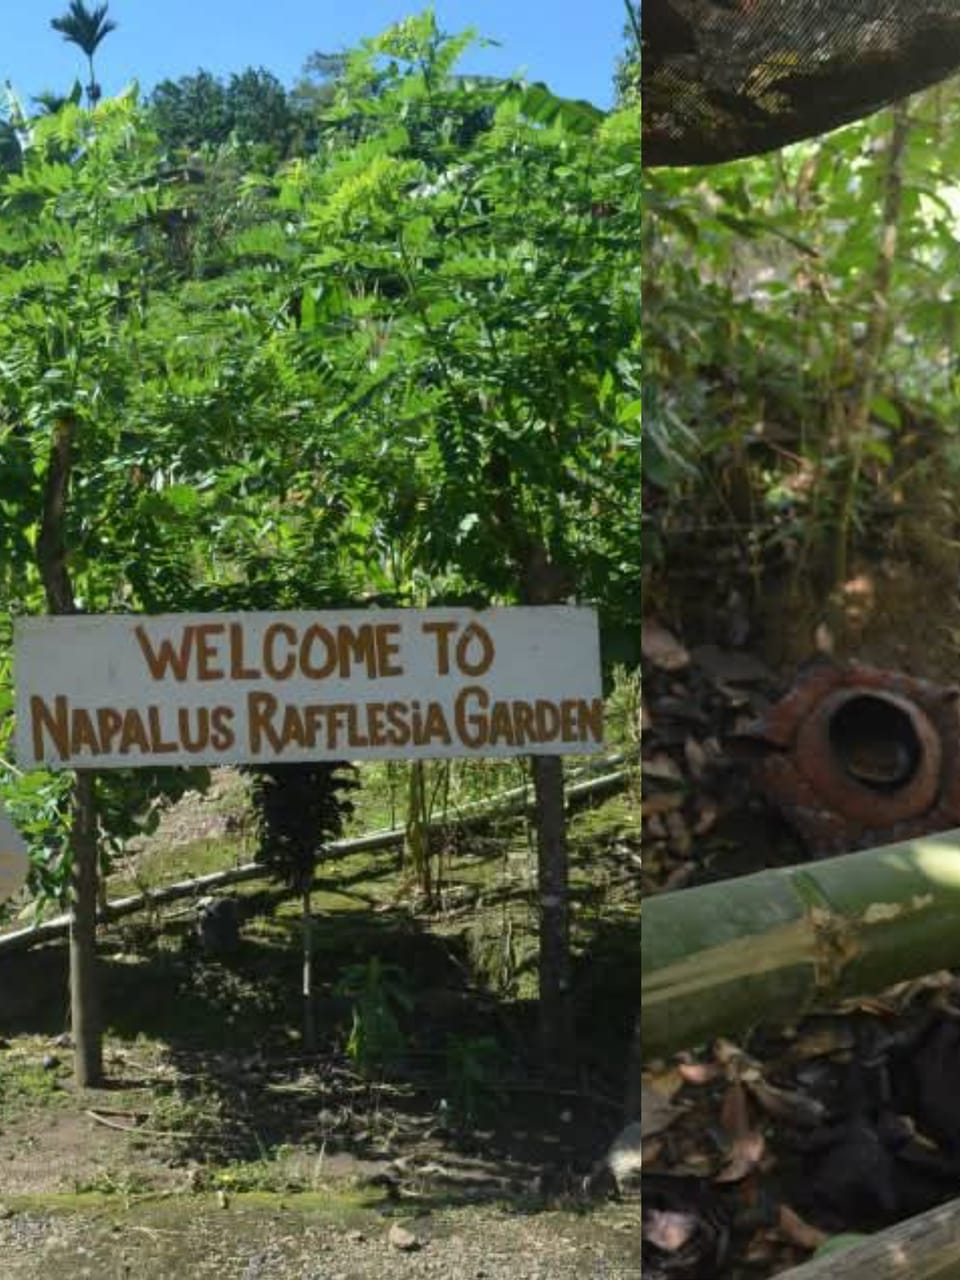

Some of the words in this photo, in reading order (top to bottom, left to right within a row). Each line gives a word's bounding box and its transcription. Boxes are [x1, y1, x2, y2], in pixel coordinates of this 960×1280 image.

[135, 621, 402, 681] WELCOME
[422, 620, 495, 677] TO
[30, 694, 235, 761] NAPALUS
[454, 686, 605, 749] GARDEN
